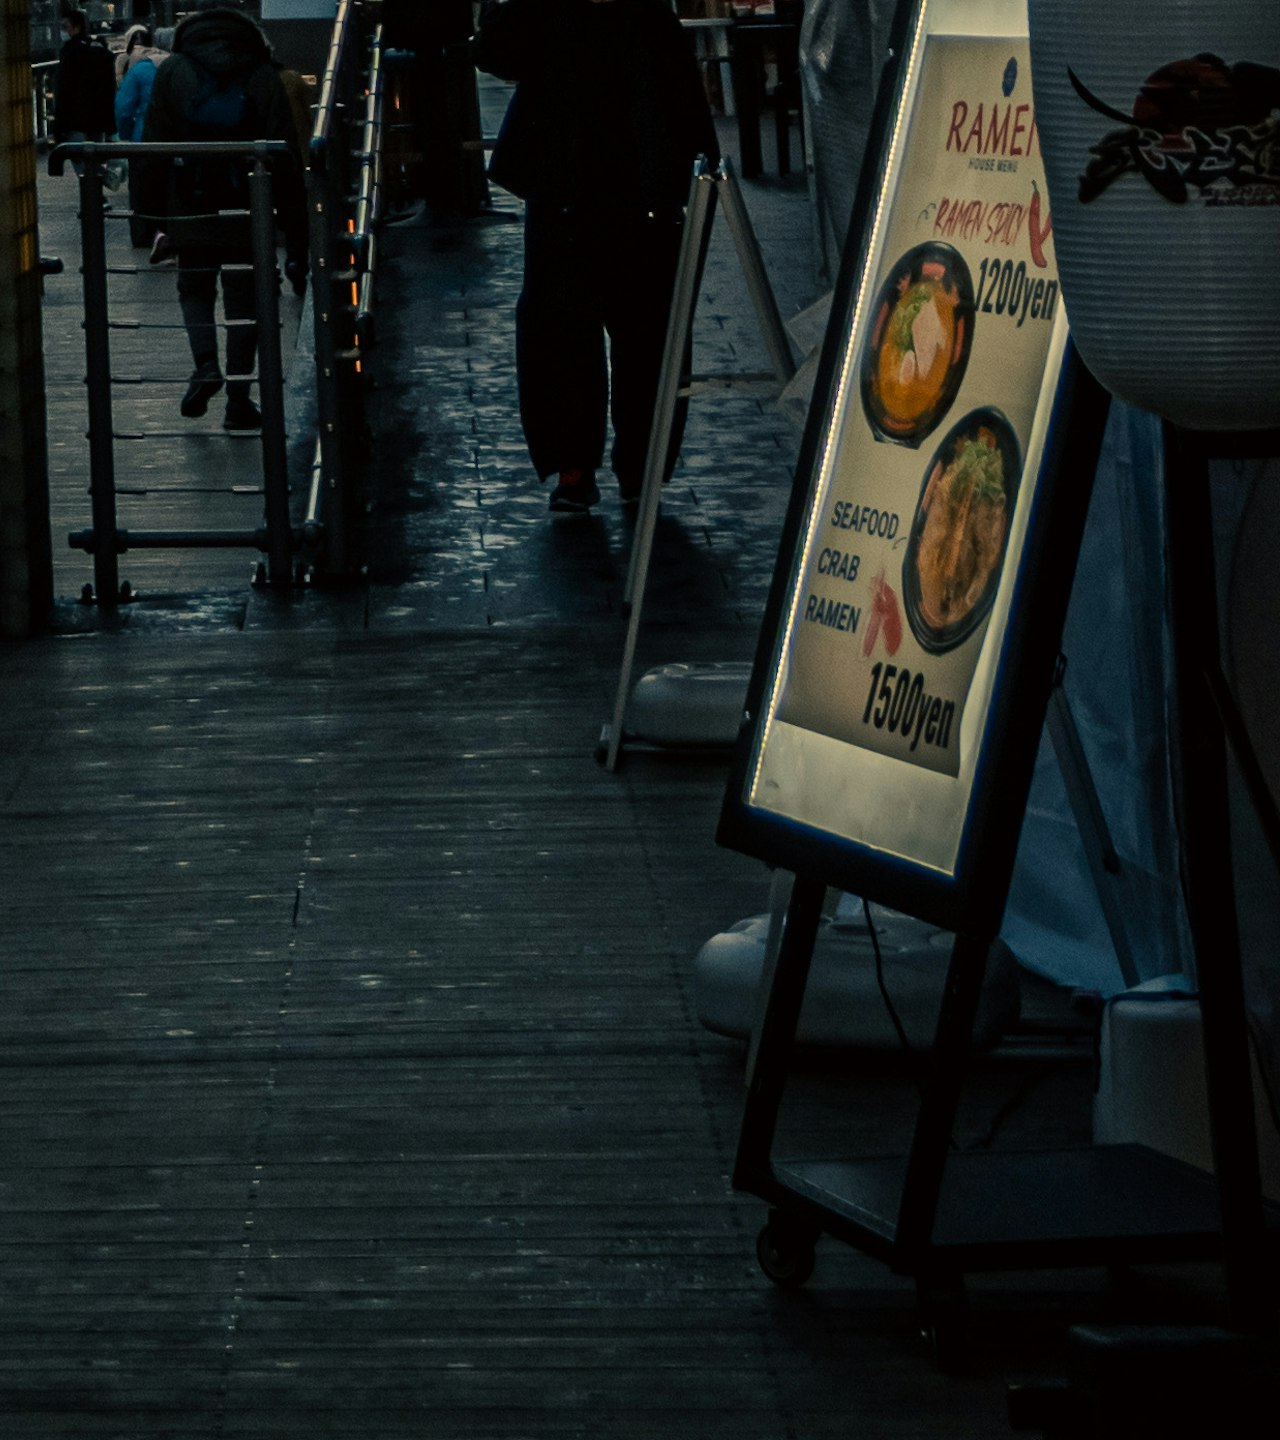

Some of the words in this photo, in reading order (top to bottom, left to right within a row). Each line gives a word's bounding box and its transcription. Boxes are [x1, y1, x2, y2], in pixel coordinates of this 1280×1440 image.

[968, 158, 994, 172] HOUSE
[996, 159, 1018, 173] MENU
[934, 196, 989, 240] RAMEN
[975, 257, 1058, 328] 1200yen
[831, 500, 900, 540] SEAFOOD
[817, 547, 861, 582] CRAB
[804, 594, 862, 634] RAMEN
[862, 661, 955, 753] 1500yen
